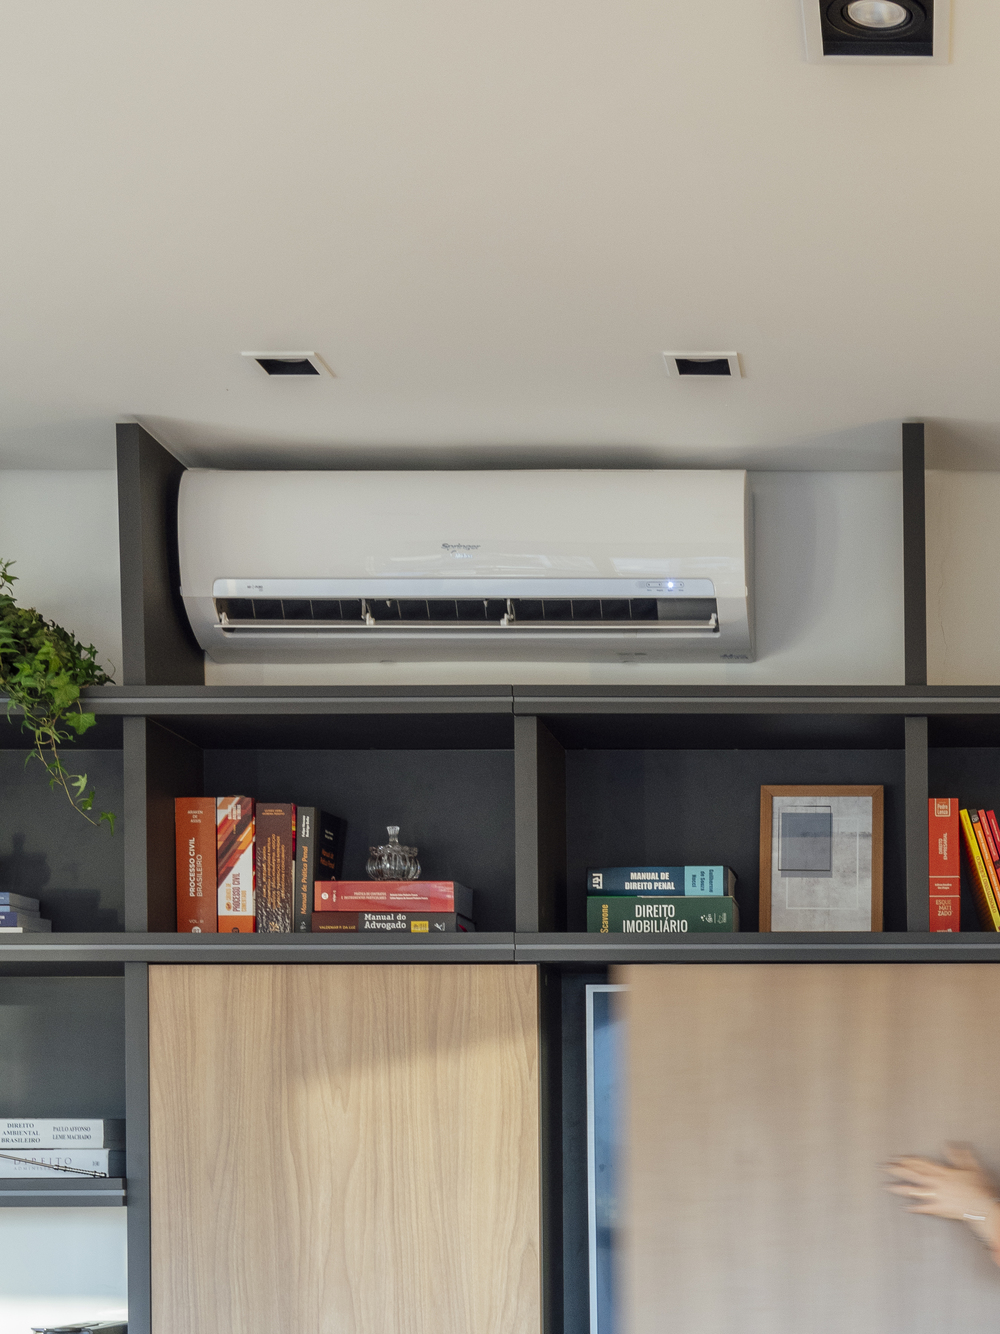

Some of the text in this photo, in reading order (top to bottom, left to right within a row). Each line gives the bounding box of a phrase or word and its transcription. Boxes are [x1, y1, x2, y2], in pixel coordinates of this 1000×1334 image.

[630, 872, 669, 880] MANUAL DE
[301, 884, 307, 892] de
[625, 882, 675, 890] DIREITO PENAL
[232, 873, 240, 912] PROCESSO CIVIL
[635, 904, 675, 918] DIREITO
[364, 913, 406, 921] Manual do
[600, 904, 609, 933] Scavone
[364, 921, 406, 930] Advogado
[623, 917, 688, 933] IMOBILIÁRIO
